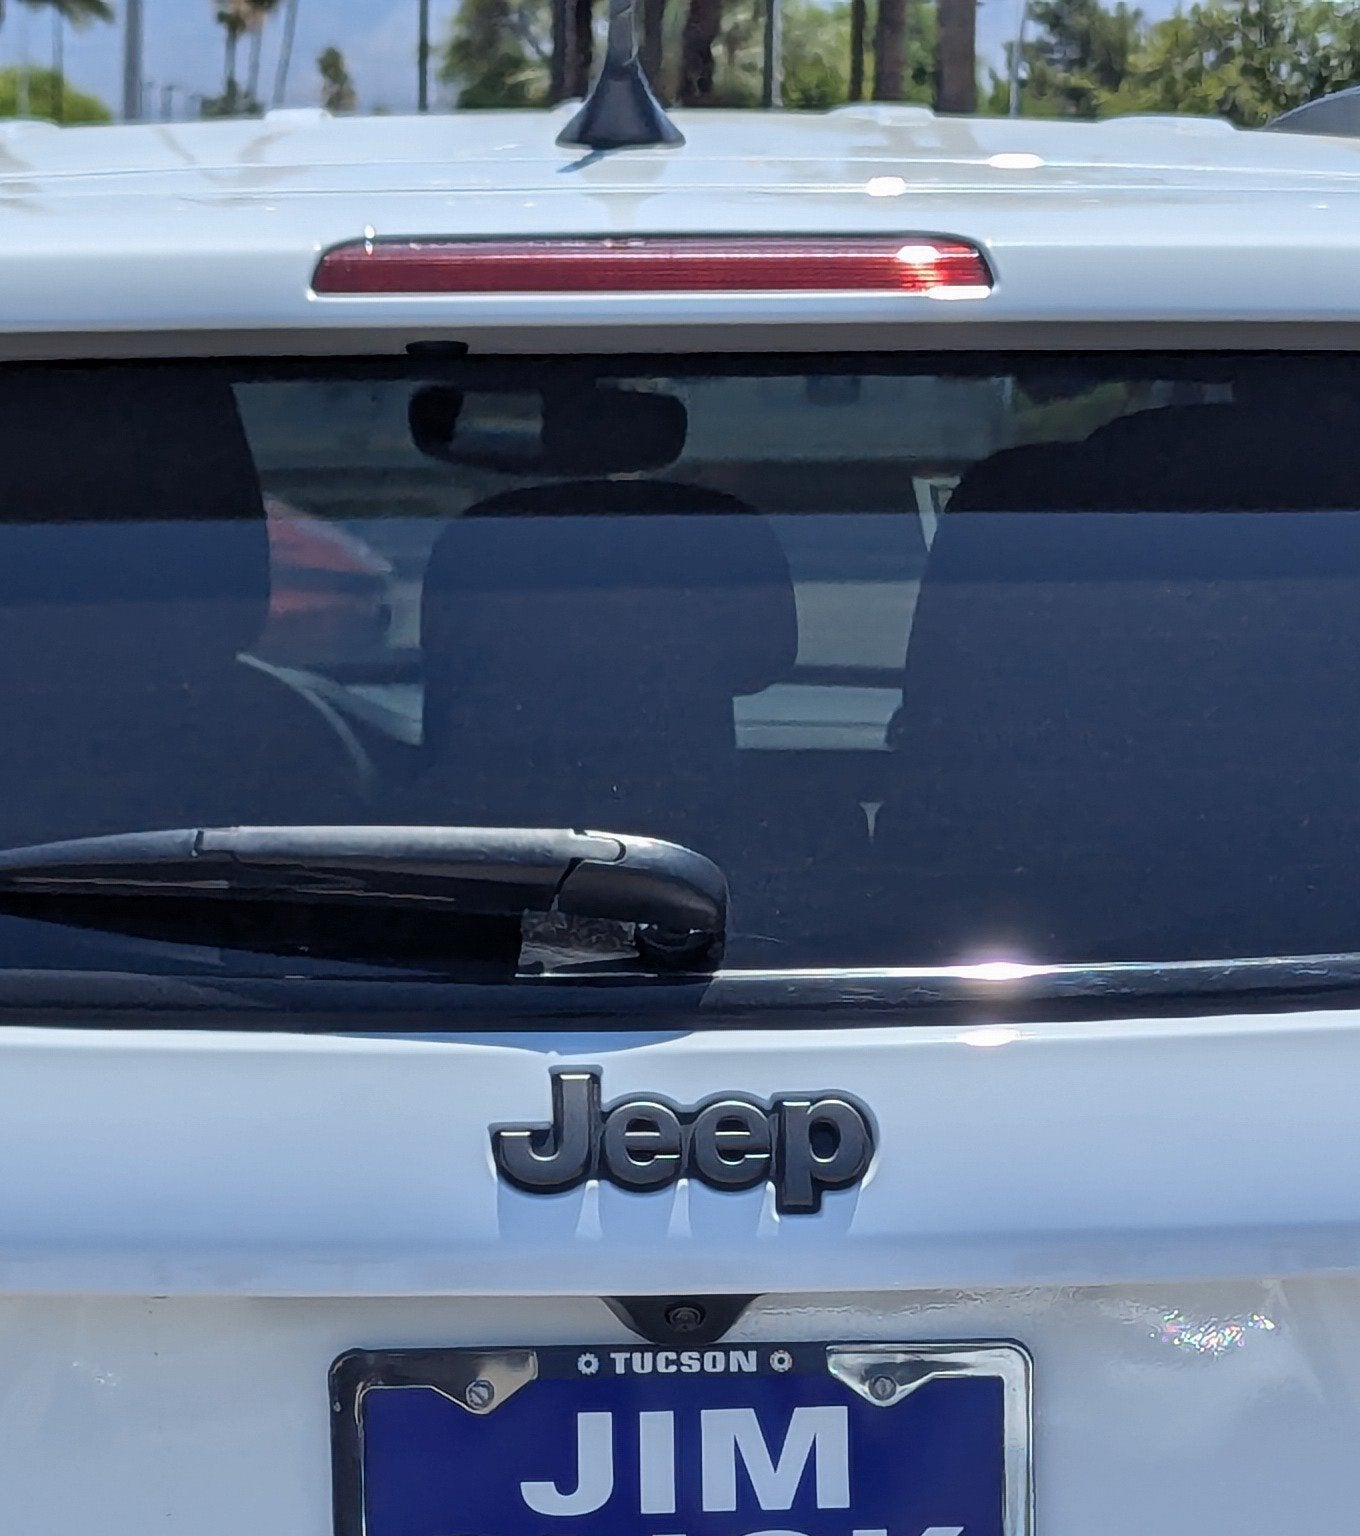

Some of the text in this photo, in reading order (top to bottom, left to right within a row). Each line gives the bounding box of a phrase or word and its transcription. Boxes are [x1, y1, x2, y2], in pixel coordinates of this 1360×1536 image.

[489, 1065, 877, 1214] Jeep
[609, 1349, 758, 1375] TUCSON
[520, 1404, 851, 1517] JIM
